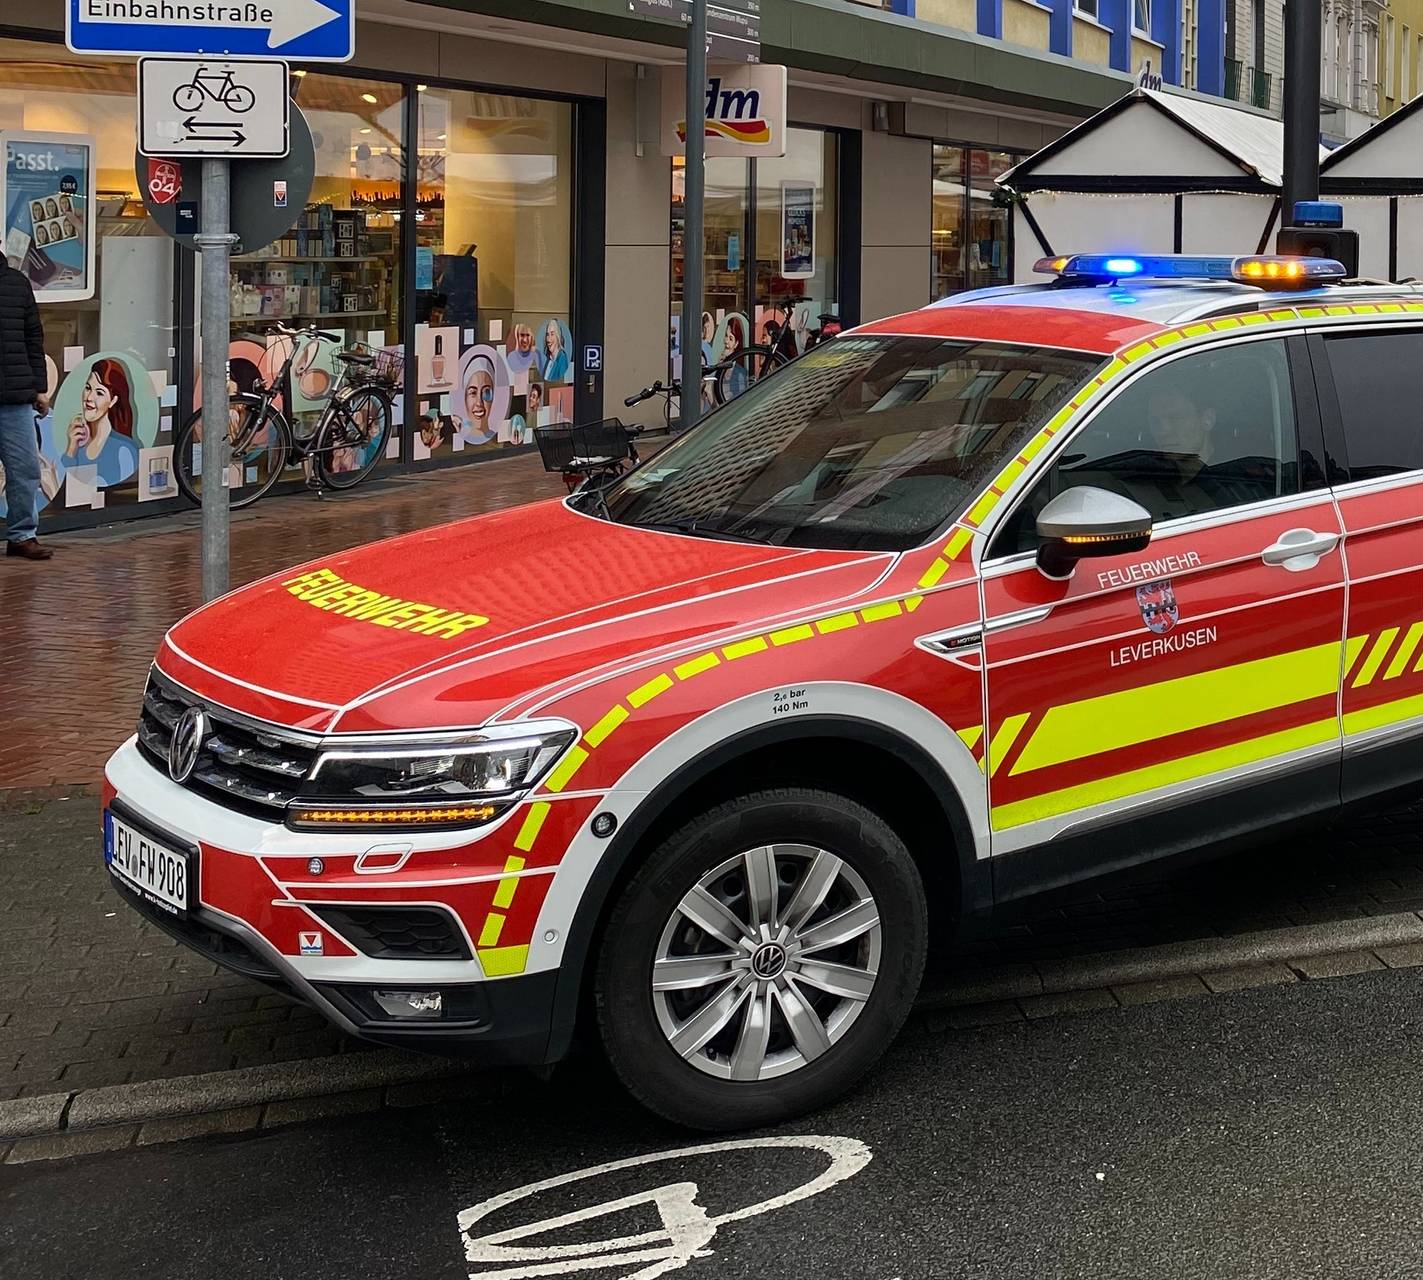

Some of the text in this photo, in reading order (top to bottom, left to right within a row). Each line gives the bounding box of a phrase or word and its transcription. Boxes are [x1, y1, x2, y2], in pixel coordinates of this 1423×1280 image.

[88, 0, 273, 23] Einbahnstraße
[150, 178, 175, 195] 04
[1097, 551, 1202, 589] FEUERWEHR
[281, 568, 490, 640] FEUERWEHR
[1110, 625, 1217, 667] LEVERKUSEN
[772, 700, 809, 715] 140 Nm
[789, 688, 806, 699] bar
[159, 852, 185, 902] 908
